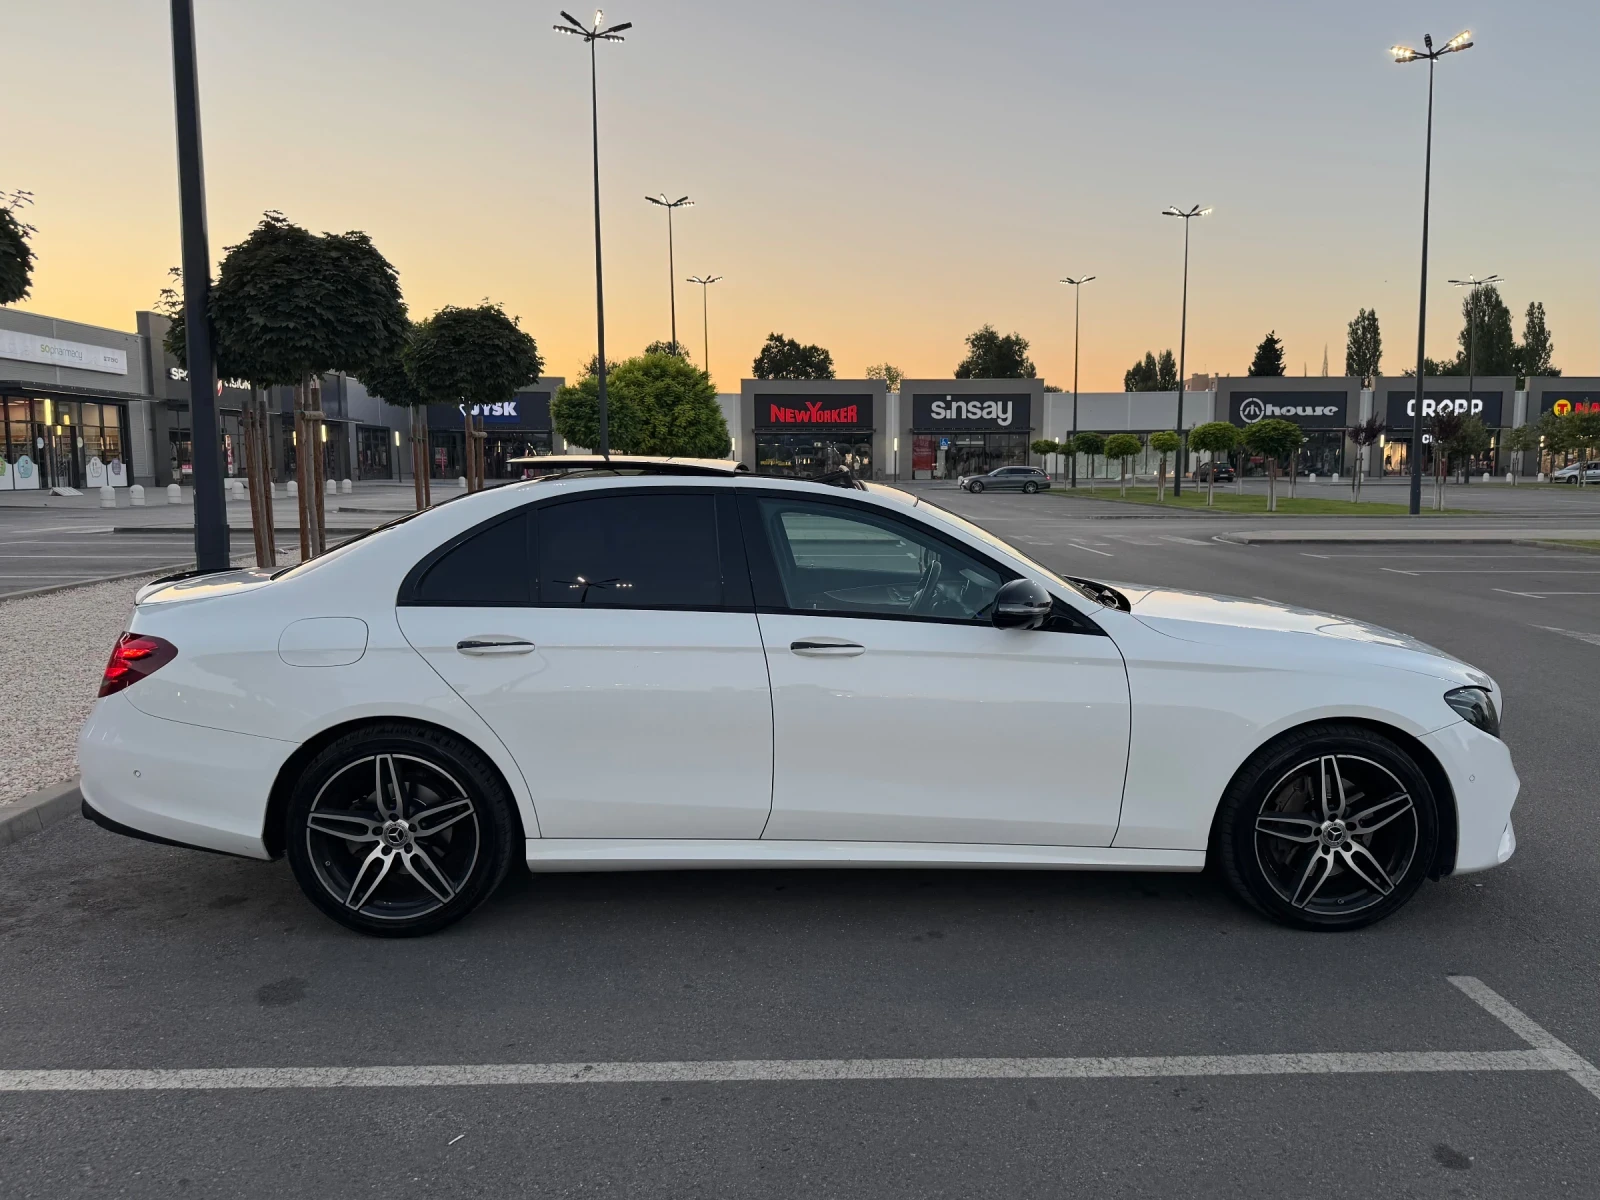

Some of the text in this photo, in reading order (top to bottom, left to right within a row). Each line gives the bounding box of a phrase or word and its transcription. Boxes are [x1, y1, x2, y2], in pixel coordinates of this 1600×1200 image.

[470, 401, 518, 416] JYSK
[930, 395, 1013, 426] sinsay
[1265, 403, 1339, 416] house
[1406, 398, 1483, 417] CROPP
